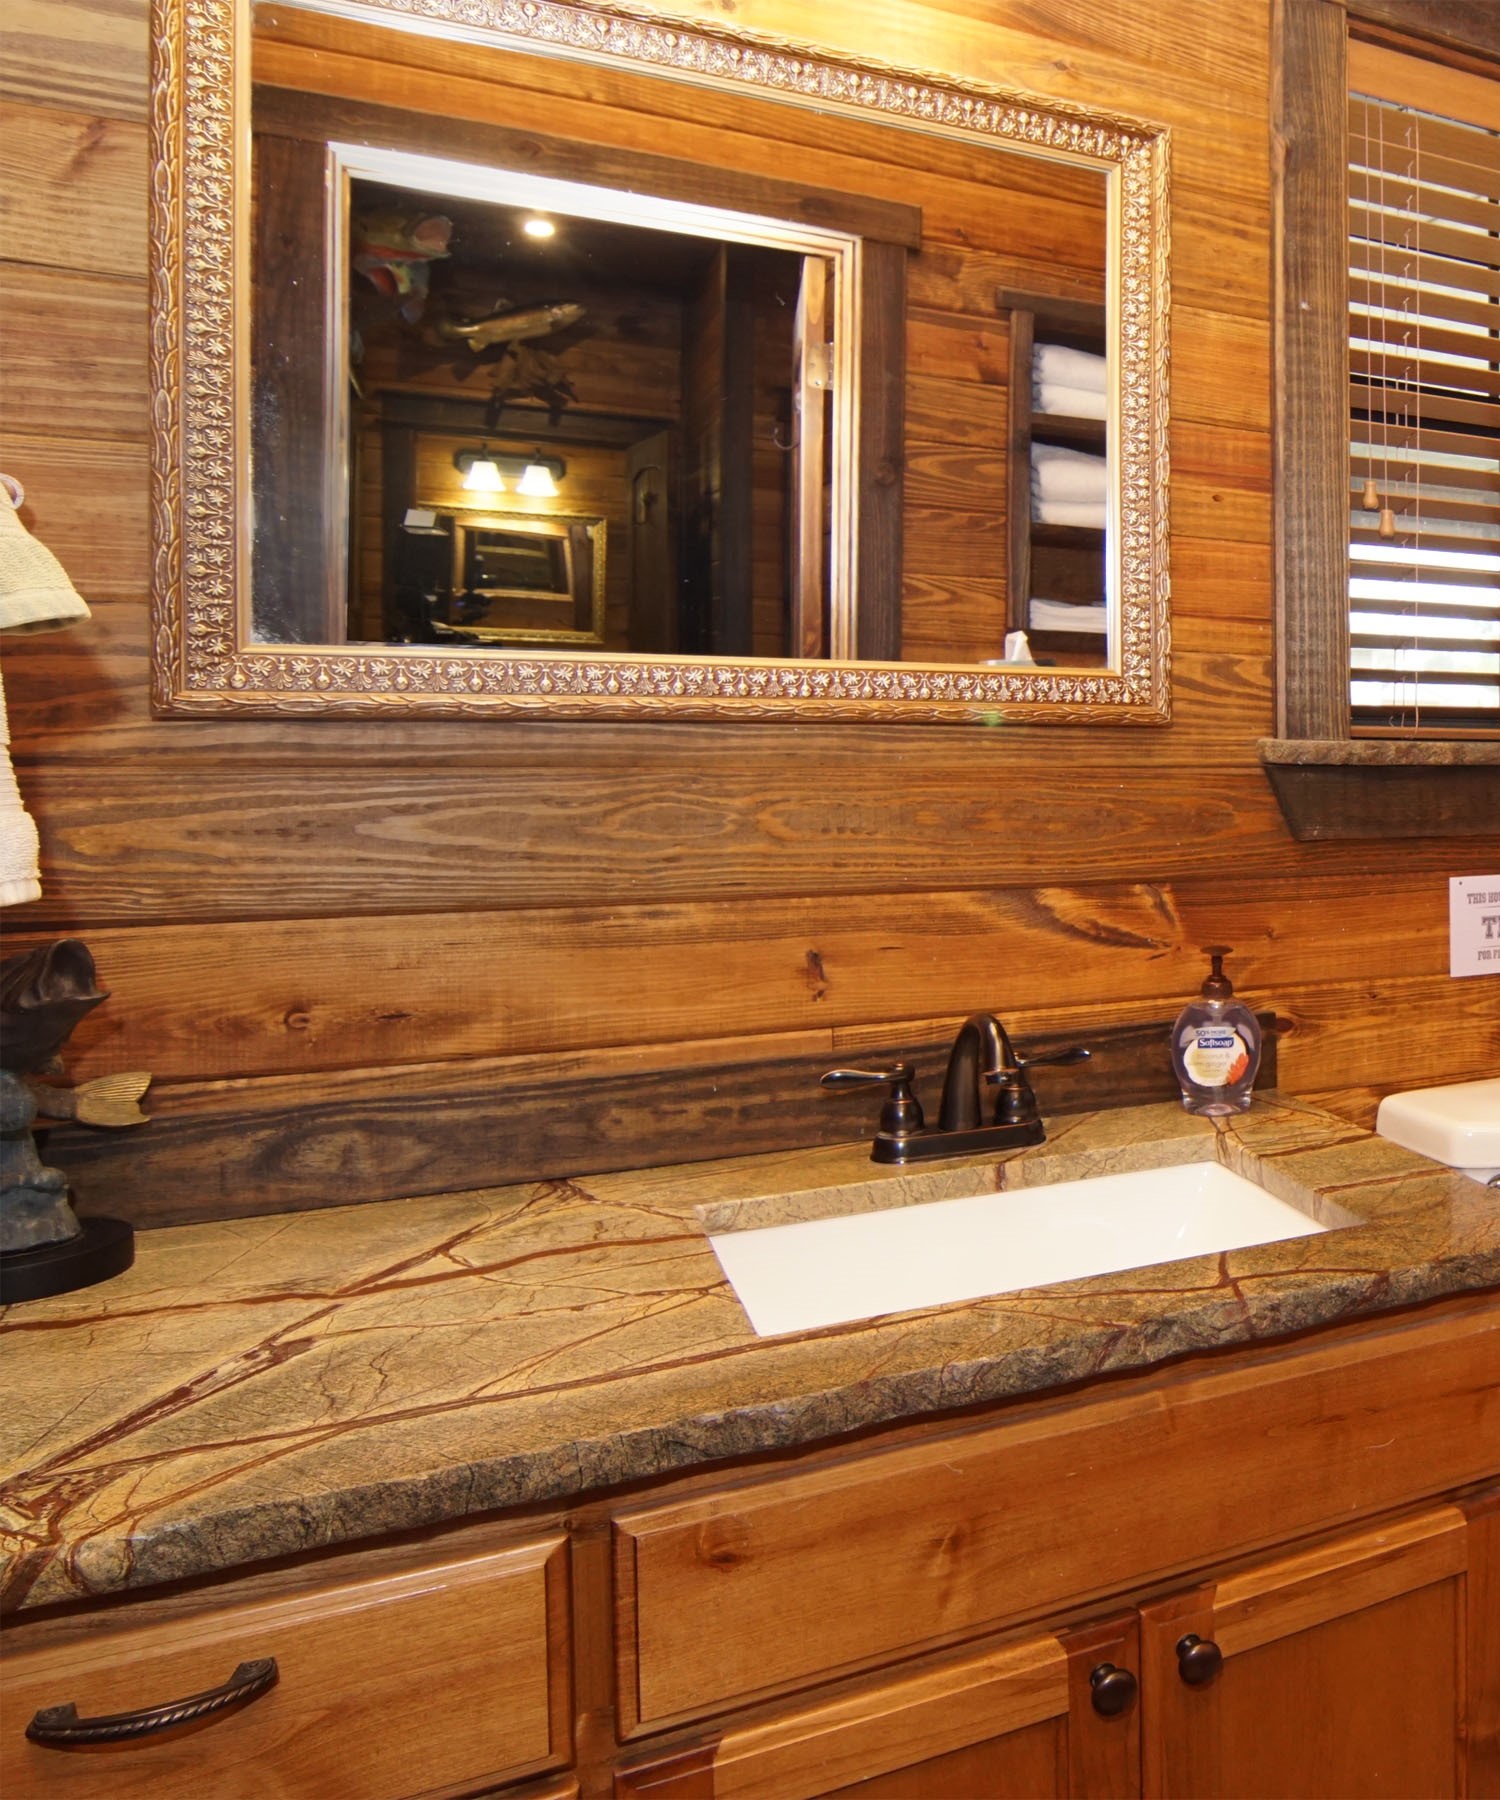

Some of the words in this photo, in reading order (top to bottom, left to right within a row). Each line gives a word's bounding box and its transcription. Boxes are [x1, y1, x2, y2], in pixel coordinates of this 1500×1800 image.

[1467, 893, 1486, 904] THIS
[1478, 950, 1492, 960] FOR
[1199, 1038, 1232, 1048] Softsoap
